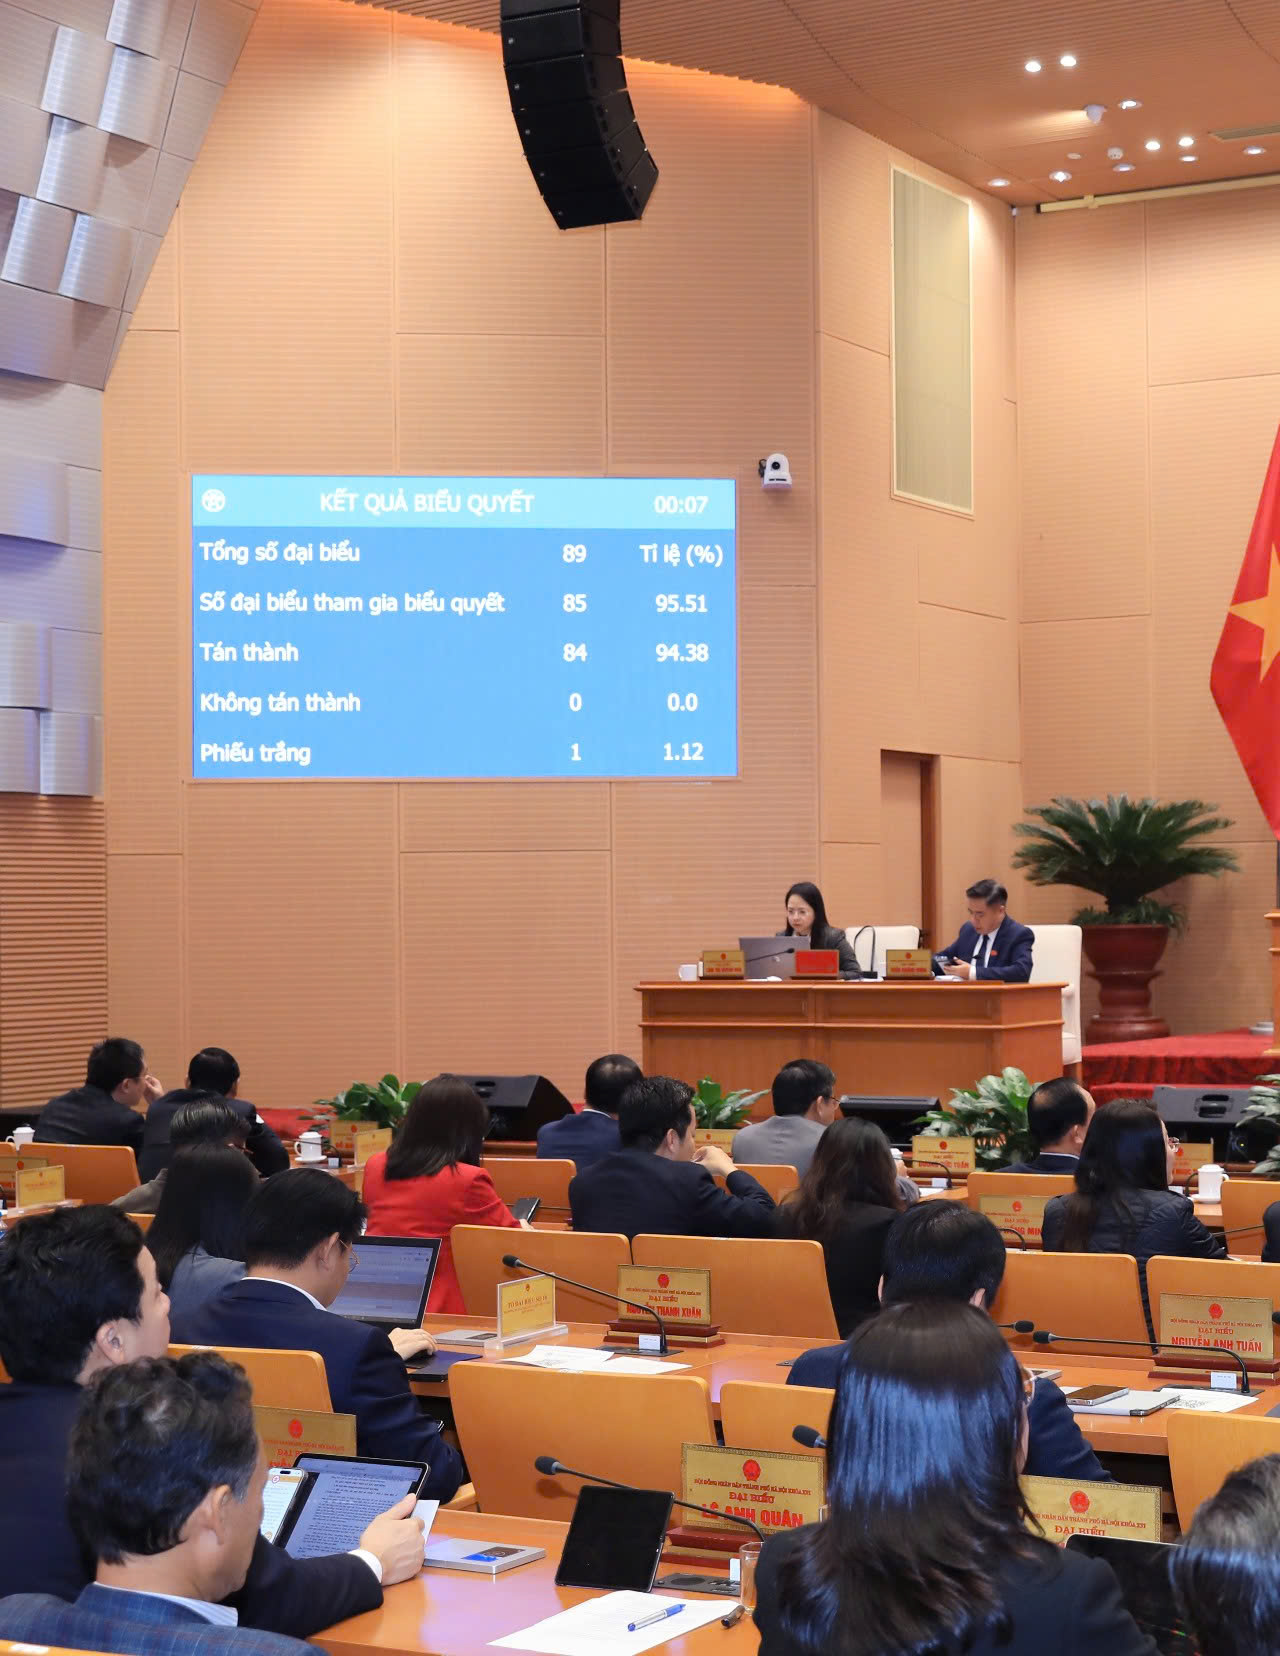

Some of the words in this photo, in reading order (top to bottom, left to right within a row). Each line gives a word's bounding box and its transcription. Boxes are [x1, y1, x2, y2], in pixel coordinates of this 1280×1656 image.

[321, 488, 358, 511] KẾT
[364, 488, 408, 515] QUẢ
[414, 489, 461, 512] BIỂU
[467, 489, 534, 516] QUYẾT
[655, 496, 708, 512] 00:07
[200, 539, 248, 565] Tổng
[255, 541, 278, 561] số
[284, 543, 312, 564] đại
[320, 540, 360, 561] biểu
[563, 544, 586, 563] 89
[664, 544, 680, 566] lệ
[686, 545, 723, 567] (%)
[200, 591, 225, 611] Số
[231, 592, 260, 615] đại
[267, 589, 307, 611] biểu
[314, 593, 363, 611] tham
[369, 594, 398, 615] gia
[405, 590, 444, 611] biểu
[451, 592, 505, 616] quyết
[563, 594, 587, 612] 85
[656, 594, 707, 612] 95.51
[200, 641, 237, 661] Tán
[243, 642, 298, 661] thành
[564, 644, 587, 661] 84
[656, 644, 708, 662] 94.38
[201, 692, 261, 716] Không
[268, 692, 299, 711] tán
[305, 692, 360, 711] thành
[570, 693, 582, 711] 0
[668, 693, 698, 711] 0.0
[201, 742, 253, 762] Phiếu
[260, 741, 310, 766] trắng
[572, 744, 581, 760] 1
[664, 742, 704, 760] 1.12
[1213, 1339, 1233, 1351] ANH
[1236, 1337, 1262, 1353] TUẤN
[729, 1491, 748, 1502] ĐẠI
[750, 1491, 775, 1504] BIỂU
[760, 1508, 803, 1528] QUÂN
